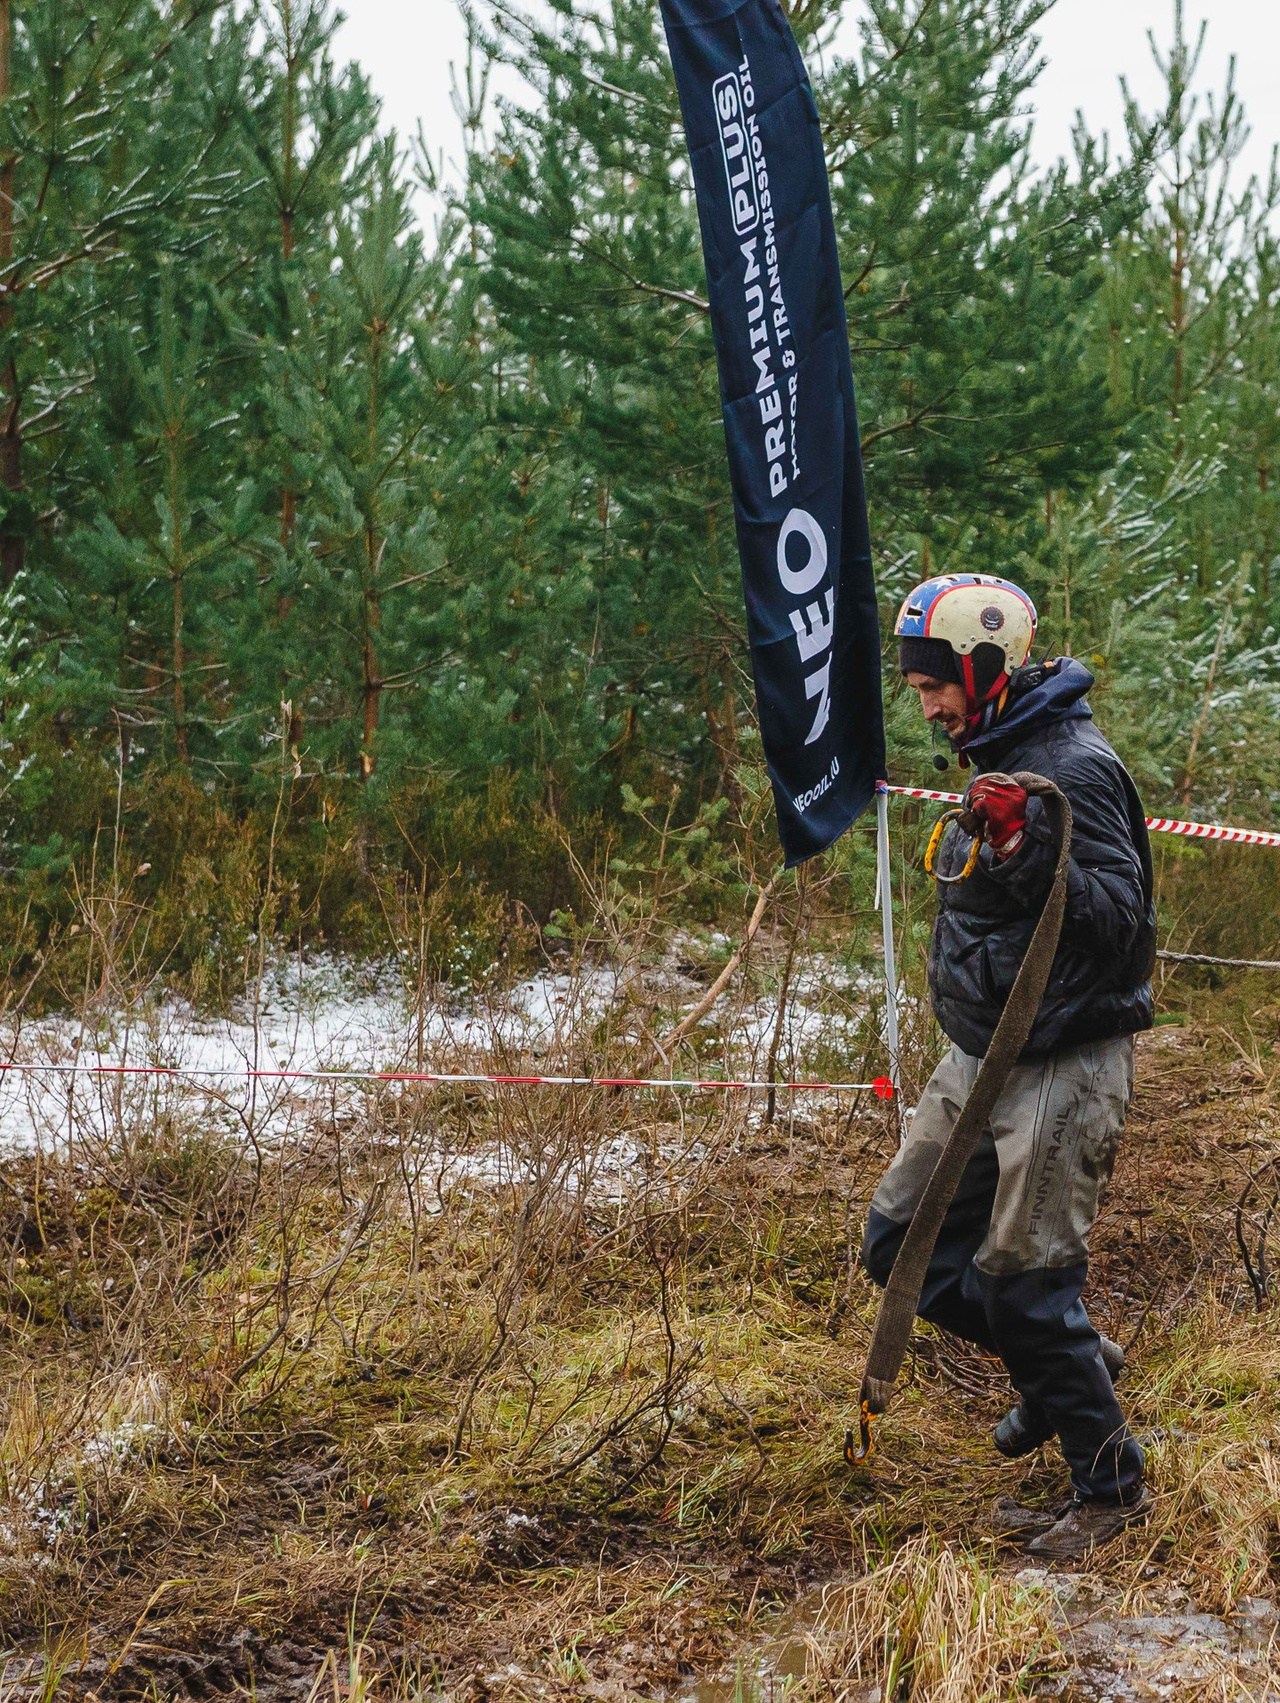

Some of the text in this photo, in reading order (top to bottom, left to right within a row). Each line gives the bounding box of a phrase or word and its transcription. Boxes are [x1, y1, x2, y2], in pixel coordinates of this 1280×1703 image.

[717, 84, 788, 498] PREMIUM PLUS
[738, 54, 801, 481] MOTOR & TRANSMISSION OIL
[776, 507, 835, 746] NEO
[1028, 1106, 1071, 1236] FINNTRAIL
